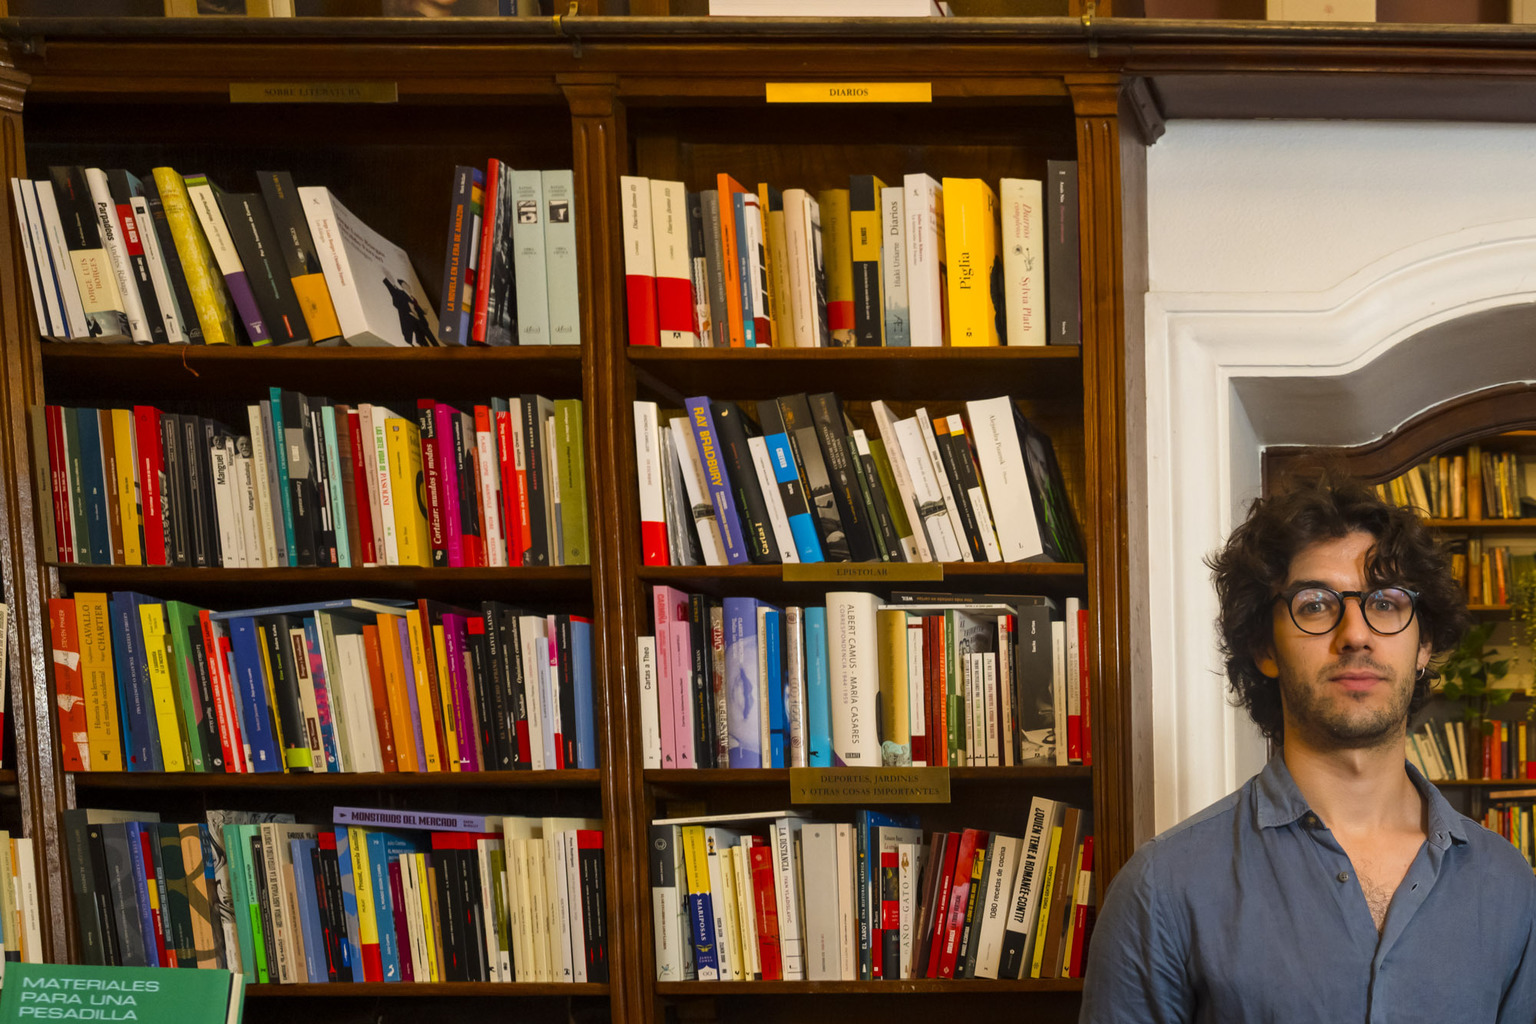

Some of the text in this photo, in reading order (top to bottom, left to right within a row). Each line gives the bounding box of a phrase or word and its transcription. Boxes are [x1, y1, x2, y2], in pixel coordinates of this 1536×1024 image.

[829, 88, 869, 97] DIARIOS
[890, 201, 899, 236] Diarios
[1022, 203, 1033, 239] Diarios
[97, 202, 129, 296] Parpadeos Andrés Rábago
[81, 258, 98, 304] JORGE LUIS
[90, 257, 102, 289] BORGES
[959, 252, 973, 290] Piglia
[1021, 277, 1032, 332] Sylvia Plath
[426, 444, 435, 471] modos
[693, 406, 723, 487] RAY BRADBURY
[215, 454, 226, 485] Manguel
[429, 479, 438, 506] mundos
[433, 508, 442, 545] Cortázar:
[836, 567, 888, 576] EPISTOLAR
[85, 604, 93, 646] CAVALLO
[97, 604, 106, 651] CHARTIER
[847, 604, 860, 745] ALBERT CAMUS MARÍA CASARES
[809, 787, 841, 795] OTRAS
[842, 787, 871, 795] COSAS
[873, 787, 940, 796] IMPORTANTES
[821, 774, 919, 784] DEPORTES, JARDINES
[351, 811, 457, 828] MONSTRUOS DEL MERCADO
[1033, 807, 1045, 832] ¿QUIÉN
[1029, 831, 1042, 854] TEME
[1013, 861, 1035, 923] ROMANÉE-CONTI?
[696, 899, 707, 941] MARIPOSAS
[21, 992, 138, 1006] PARA UNA
[23, 977, 160, 992] MATERIALES
[19, 1006, 138, 1021] PESADILLA
